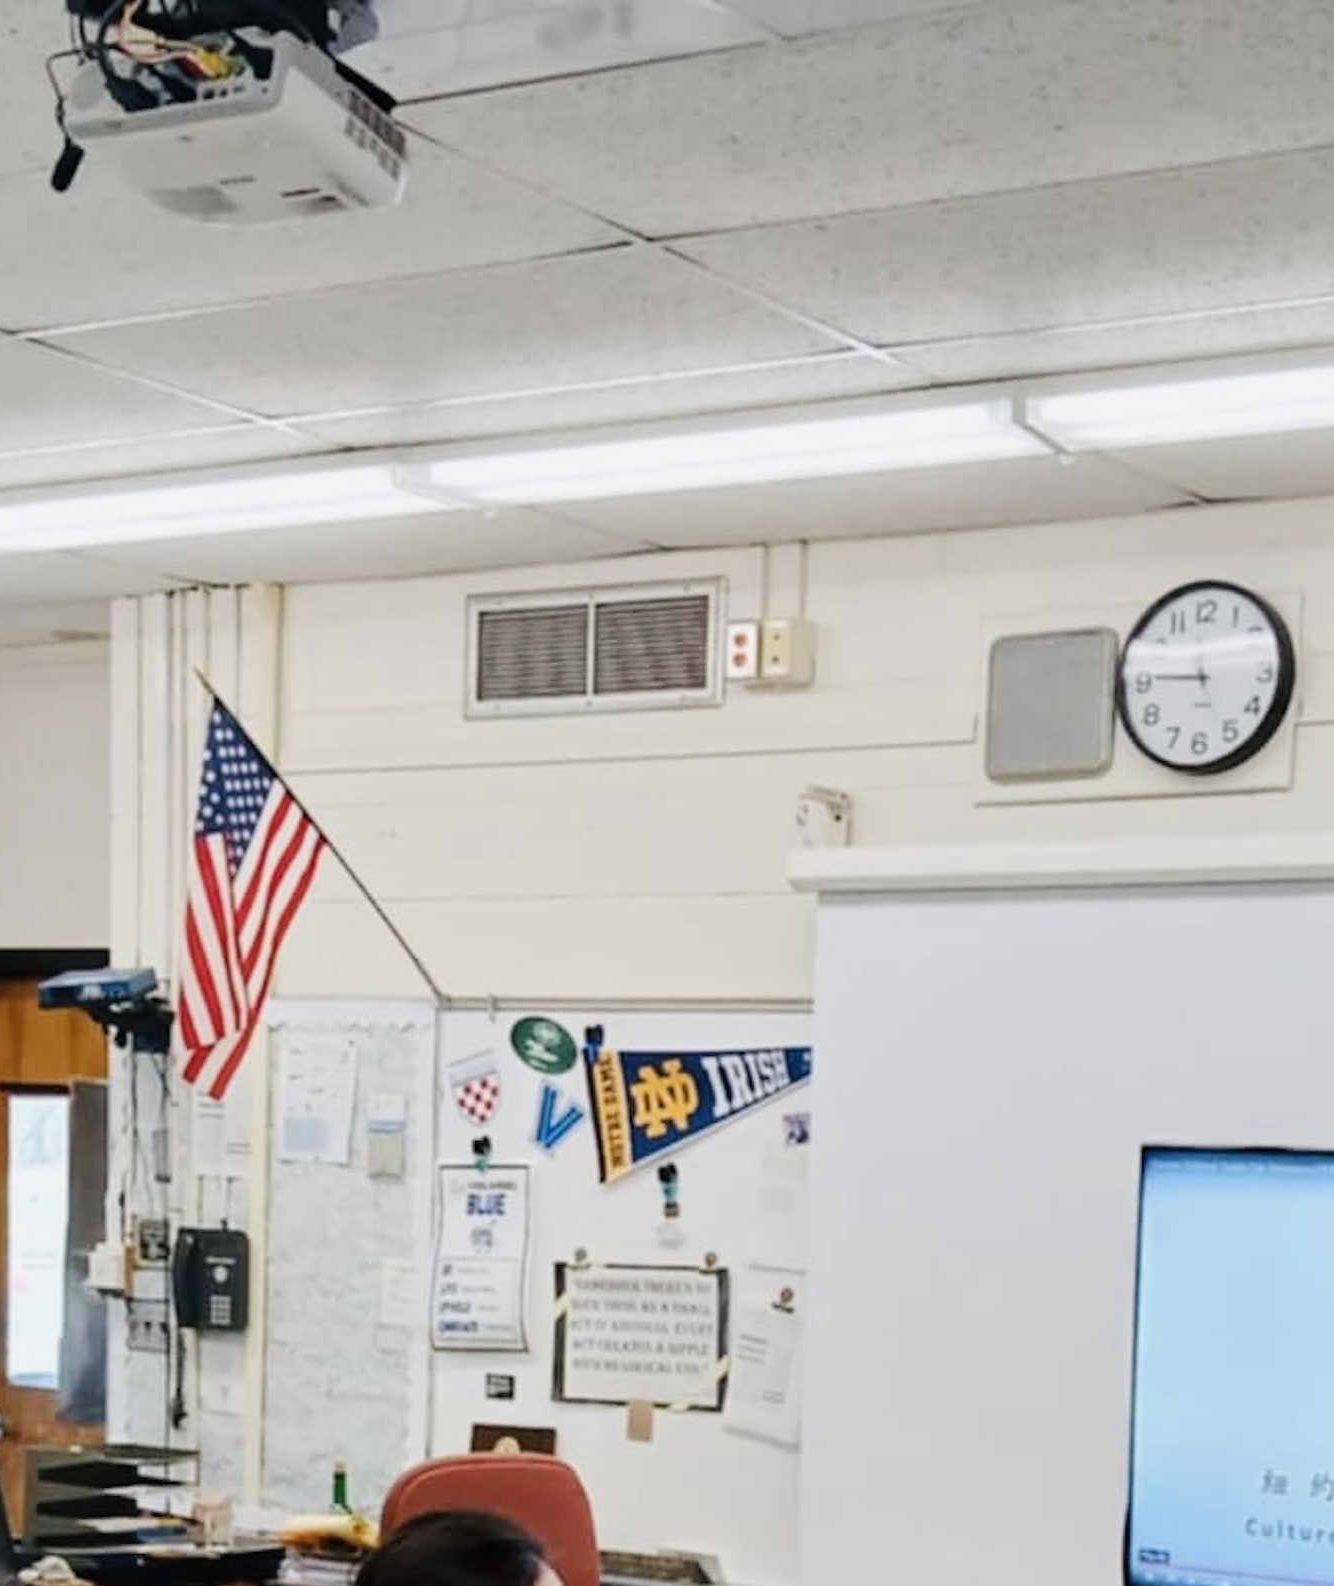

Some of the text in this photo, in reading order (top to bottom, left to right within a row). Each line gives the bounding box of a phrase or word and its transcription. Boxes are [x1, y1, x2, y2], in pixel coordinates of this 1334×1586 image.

[1170, 611, 1186, 635] 11
[1196, 600, 1218, 625] 12
[1135, 672, 1152, 695] 9
[1256, 661, 1274, 684] 3
[1143, 703, 1160, 726] 8
[1243, 694, 1261, 717] 4
[1166, 726, 1182, 749] 7
[1221, 719, 1239, 743] 5
[1190, 731, 1208, 755] 6
[700, 1050, 790, 1118] IRISH
[467, 1193, 506, 1216] BLUE
